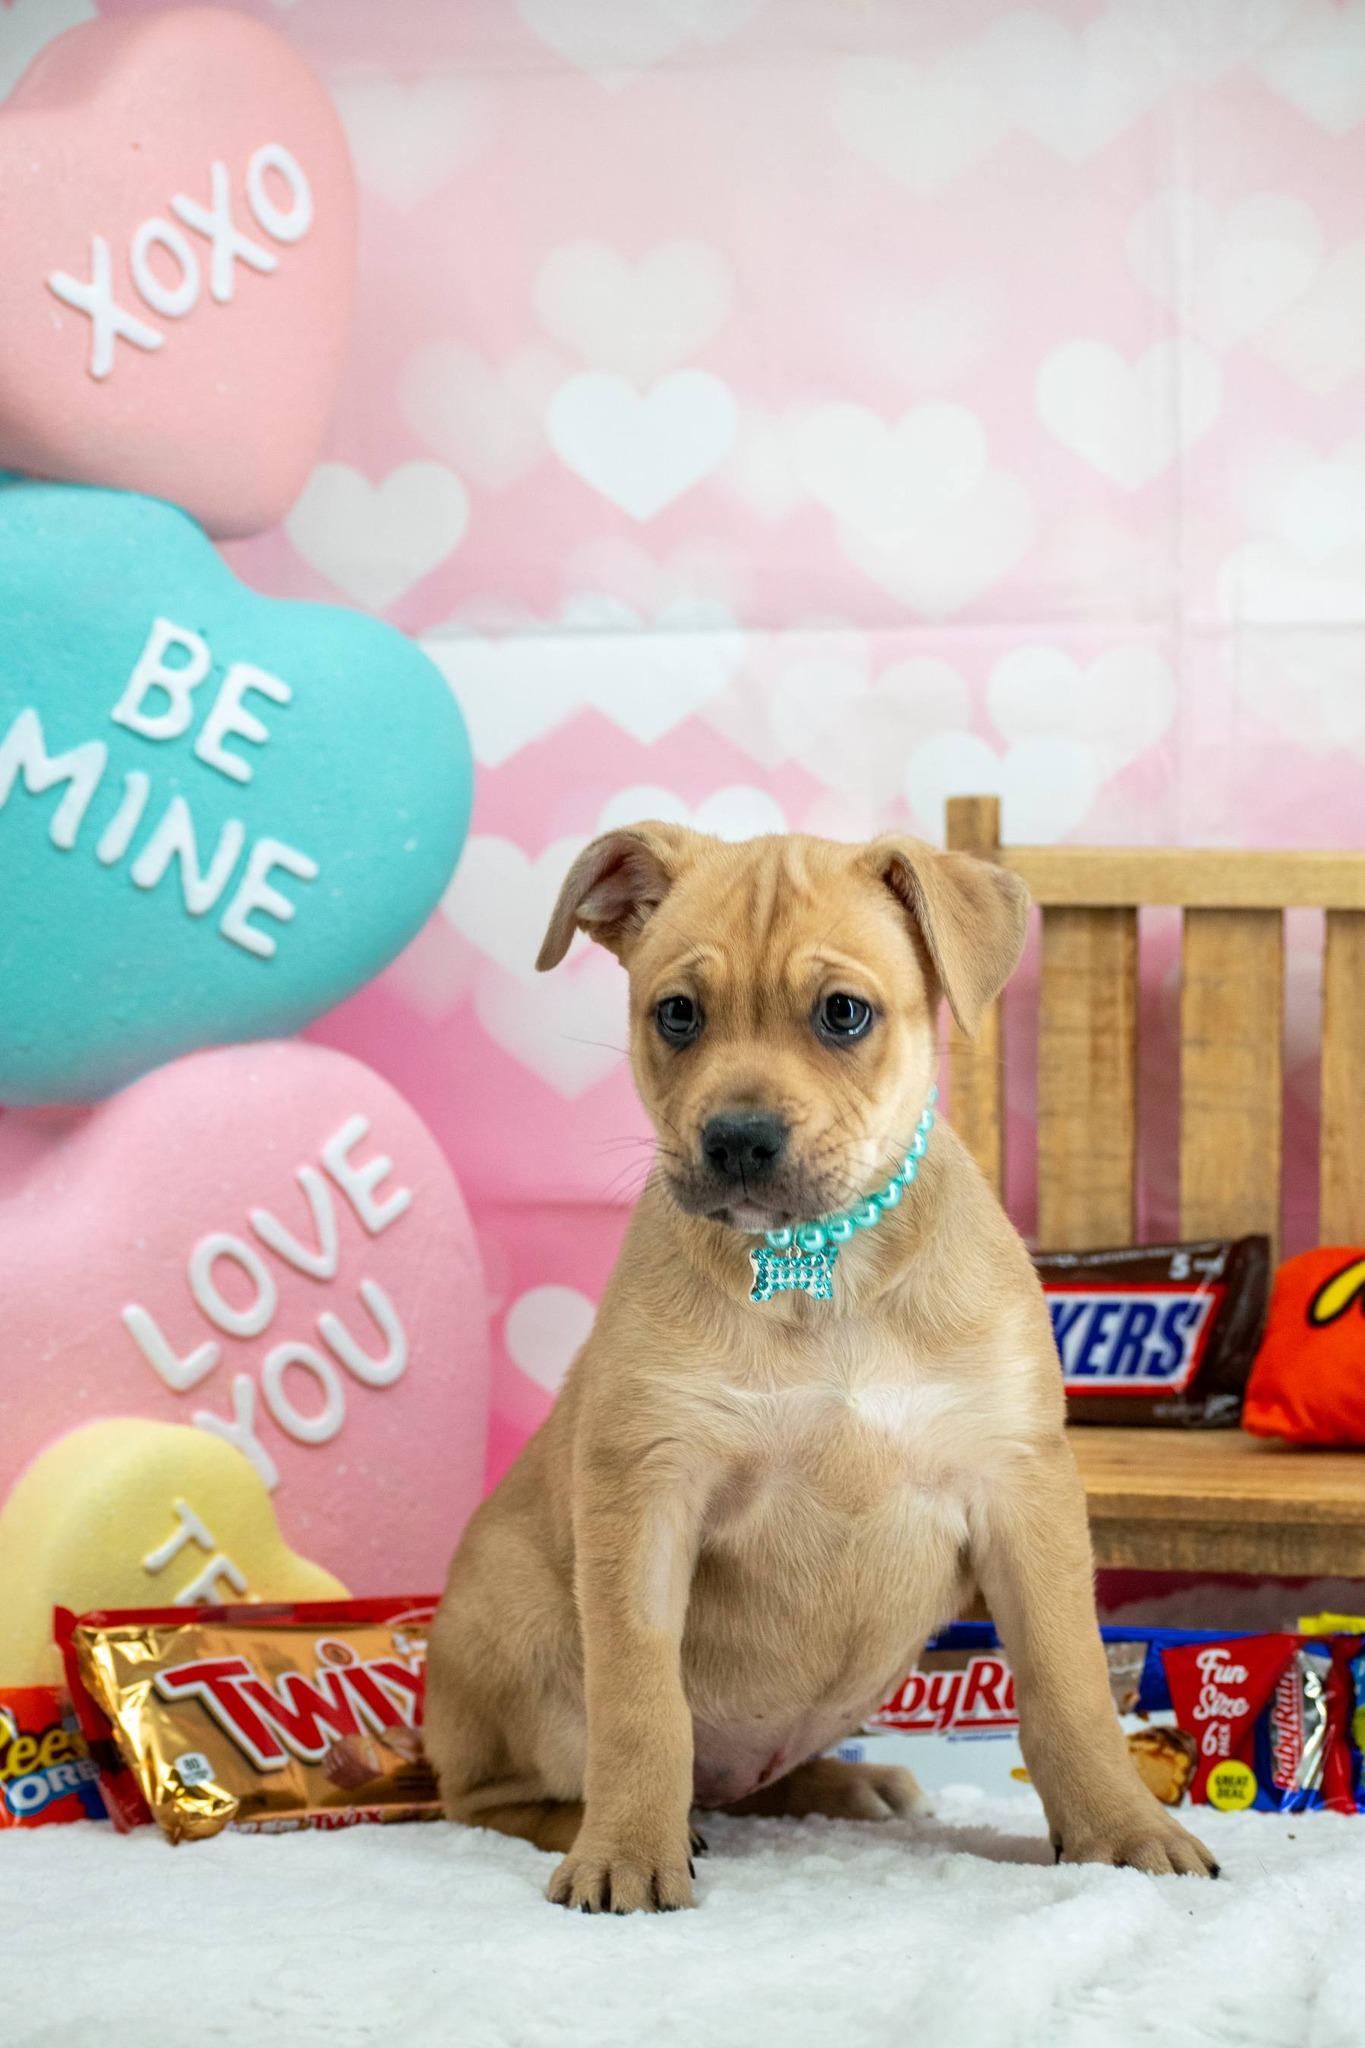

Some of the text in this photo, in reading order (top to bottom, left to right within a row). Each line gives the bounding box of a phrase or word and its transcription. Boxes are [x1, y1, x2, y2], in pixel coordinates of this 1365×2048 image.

[47, 144, 313, 379] XOXO
[111, 616, 292, 783] BE
[0, 706, 319, 958] MINE
[122, 1113, 411, 1392] LOVE
[193, 1279, 408, 1490] YOU
[1192, 1684, 1250, 1721] Size
[1196, 1648, 1248, 1684] Fun
[1202, 1721, 1219, 1757] 6
